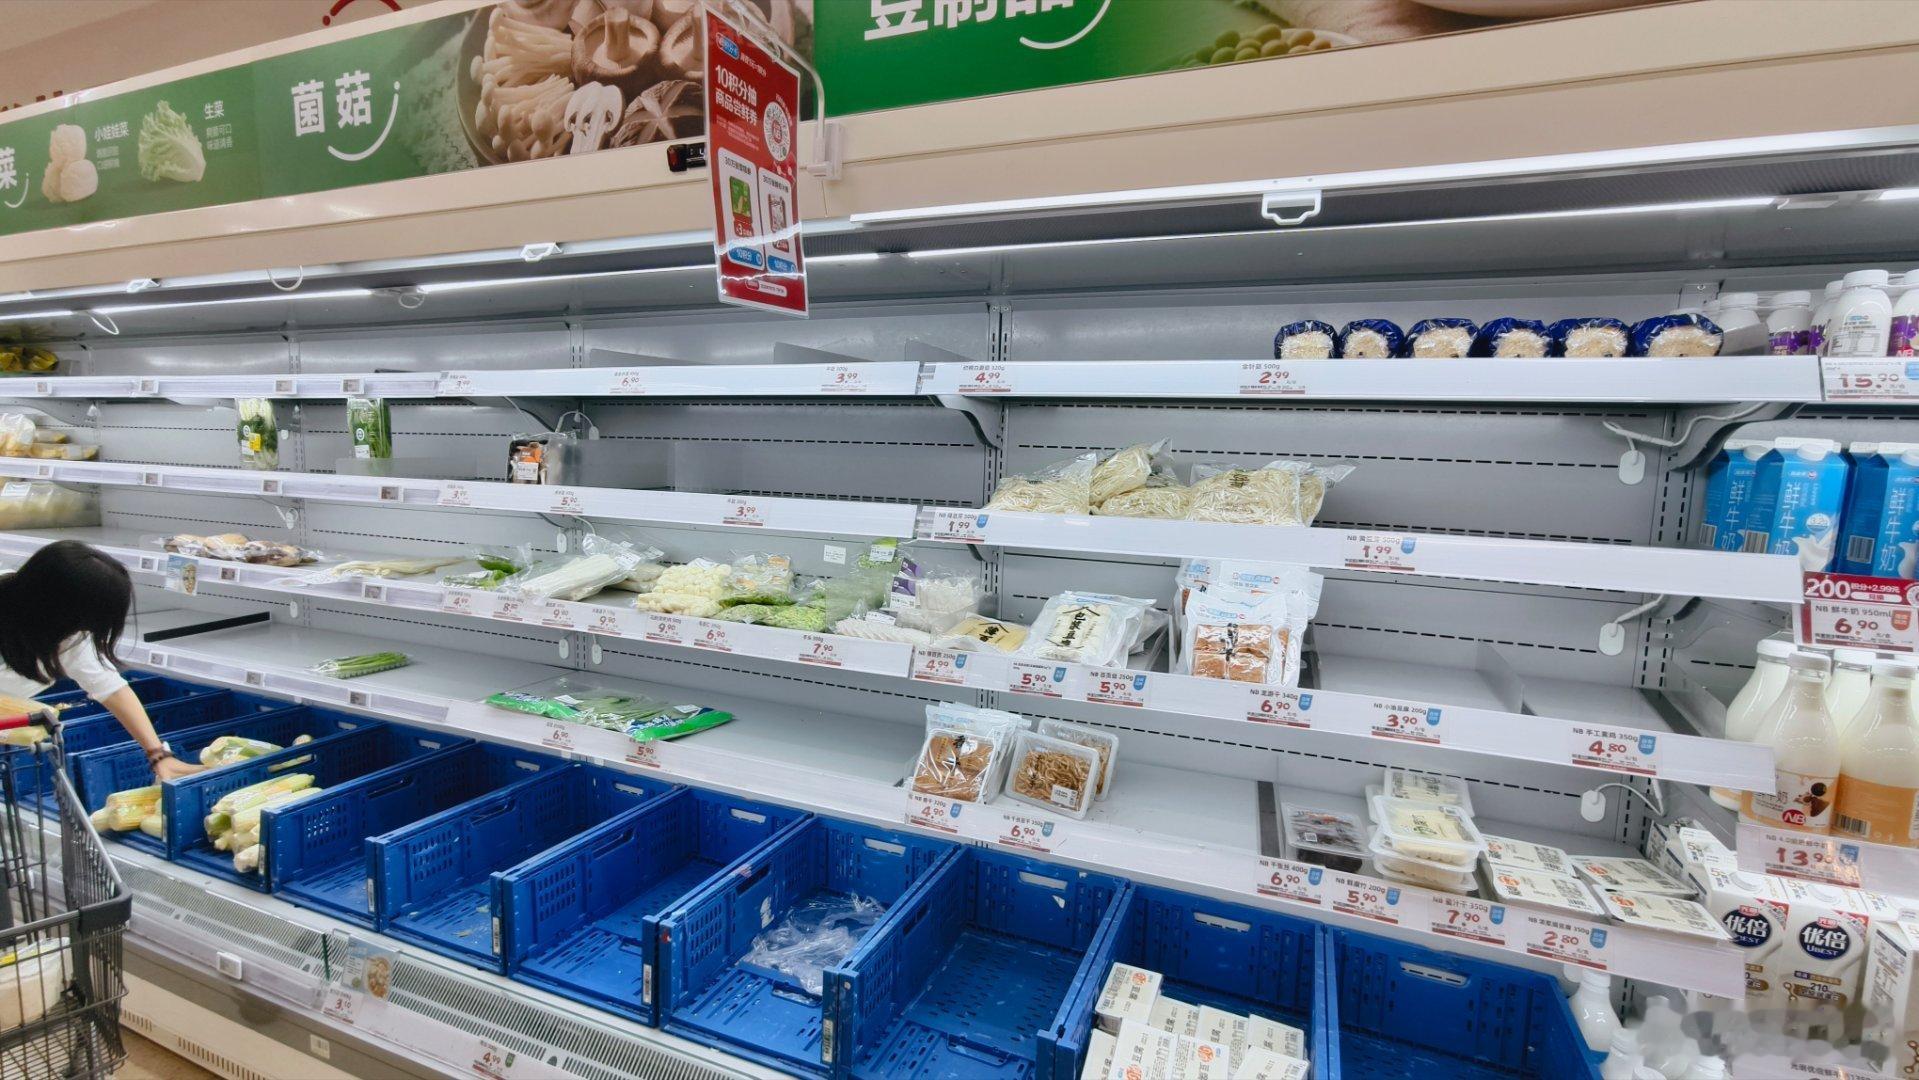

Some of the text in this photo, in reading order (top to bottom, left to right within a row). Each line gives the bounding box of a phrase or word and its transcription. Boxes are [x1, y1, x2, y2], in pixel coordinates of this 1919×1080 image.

[715, 64, 757, 107] 10积分抽
[204, 100, 225, 120] 生菜
[291, 70, 373, 137] 菌菇
[715, 87, 758, 126] 商品尝鲜券
[95, 121, 130, 142] 小娃娃菜
[620, 377, 640, 389] 6.90
[835, 373, 858, 385] 3.99
[975, 371, 1001, 384] 4.99
[1258, 371, 1290, 385] 2.99
[1837, 373, 1900, 390] 15.90
[560, 496, 578, 507] 5.90
[735, 506, 757, 518] 3.99
[947, 521, 971, 534] 1.99
[1879, 487, 1908, 571] 鲜牛奶
[1382, 537, 1401, 545] 500g
[1362, 545, 1392, 559] 1.99
[1804, 578, 1852, 600] 200
[553, 609, 570, 620] 9.90
[1815, 605, 1829, 613] NB
[1831, 606, 1860, 616] 鲜牛奶
[599, 616, 617, 627] 9.90
[658, 622, 677, 635] 9.90
[1834, 618, 1879, 636] 6.90
[706, 629, 726, 642] 6.90
[812, 642, 834, 656] 7.90
[926, 660, 950, 673] 4.99
[1020, 673, 1047, 687] 5.90
[1119, 673, 1134, 681] 250g
[1099, 681, 1127, 695] 5.90
[1261, 699, 1291, 715] 6.90
[1411, 707, 1427, 716] 200g
[1387, 713, 1418, 729] 3.90
[552, 730, 569, 742] 6.90
[1572, 727, 1584, 735] NB
[1619, 734, 1639, 743] 350g
[637, 746, 655, 758] 5.90
[1588, 740, 1628, 758] 4.80
[921, 806, 945, 819] 4.90
[1784, 812, 1807, 825] NB
[1011, 824, 1036, 840] 6.90
[1766, 833, 1777, 841] NB
[1776, 846, 1833, 868] 13.90
[1292, 865, 1308, 875] 400g
[1270, 871, 1301, 888] 6.90
[1369, 884, 1386, 895] 200g
[1347, 889, 1378, 907] 5.90
[1432, 896, 1489, 913] NB 蜜汁干 350g
[1447, 909, 1481, 928] 7.90
[1574, 926, 1590, 935] 350g
[1724, 914, 1770, 938] 优倍
[1542, 930, 1580, 949] 2.80
[1801, 926, 1848, 950] 优倍
[1810, 982, 1829, 992] 210
[334, 998, 352, 1010] 3.10
[482, 1051, 501, 1066] 4.99
[1791, 1063, 1846, 1080] 光明优倍鲜牛
